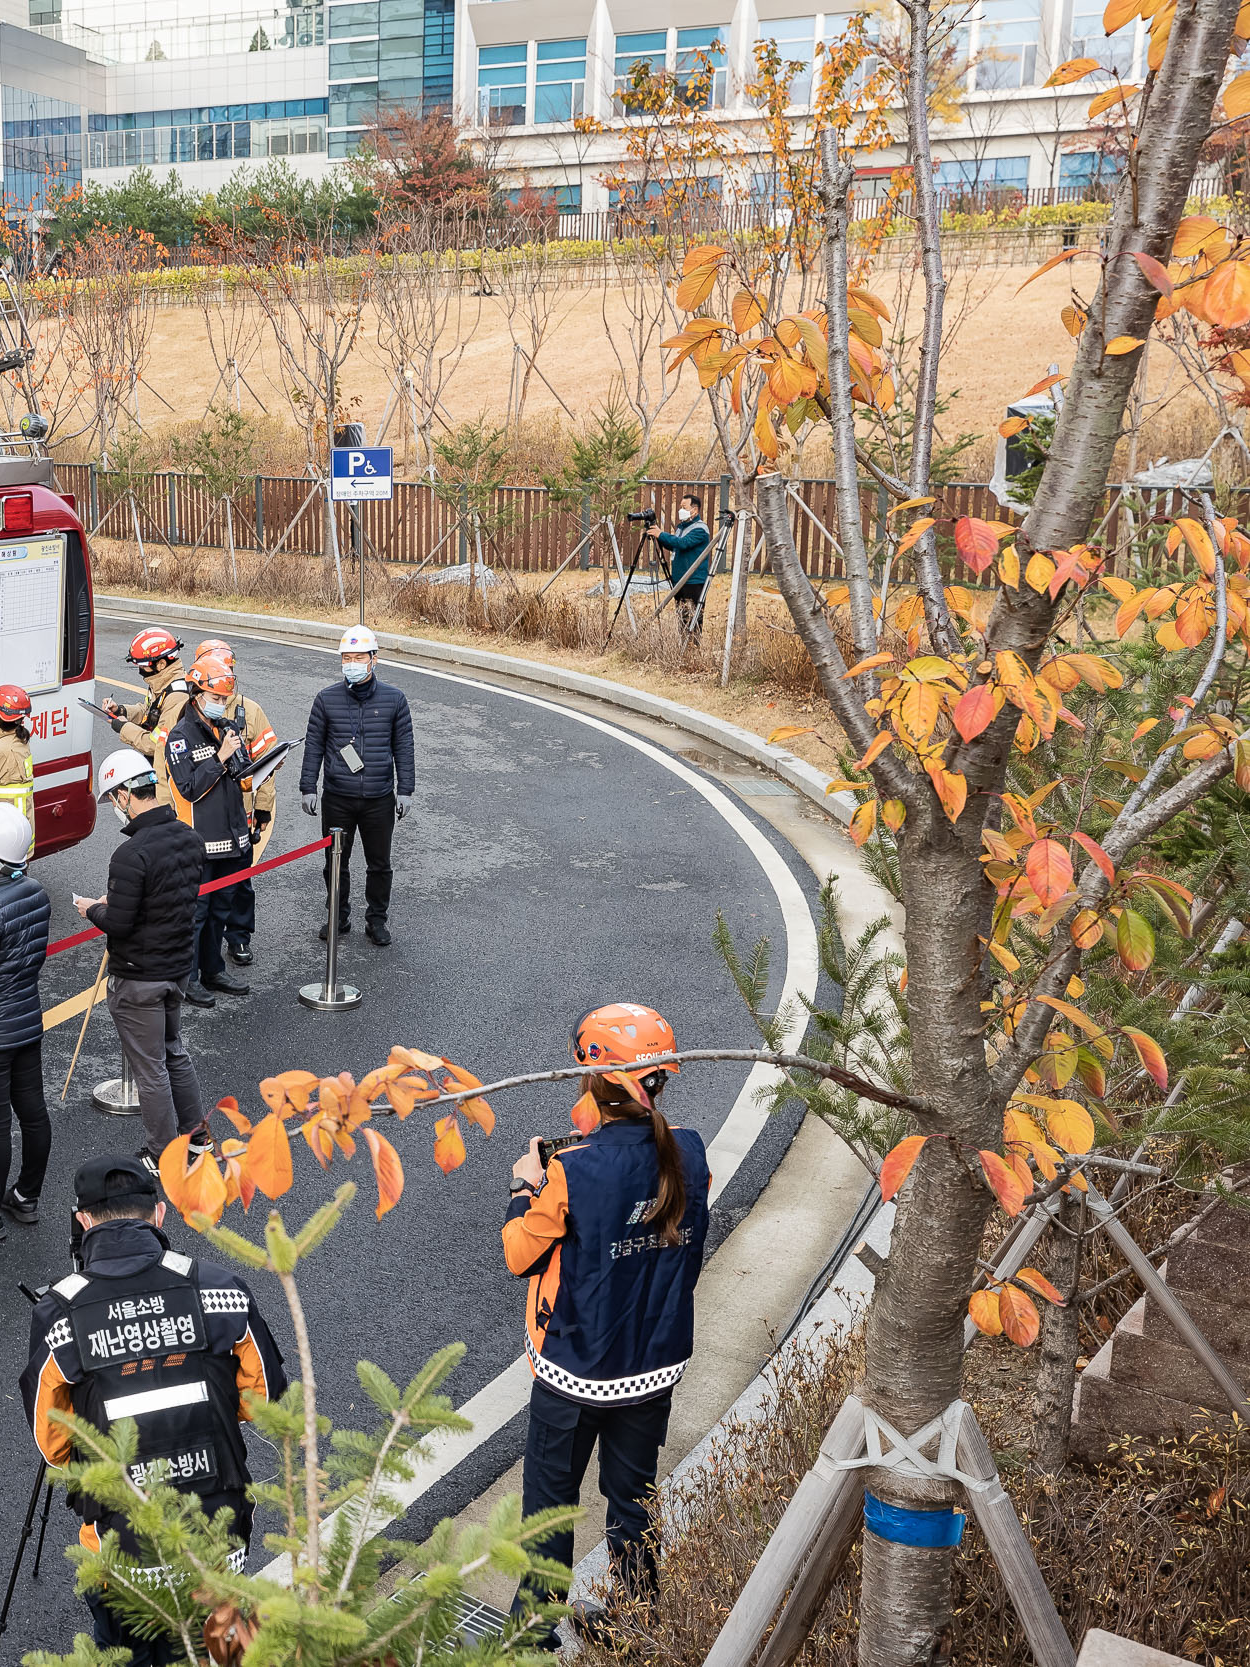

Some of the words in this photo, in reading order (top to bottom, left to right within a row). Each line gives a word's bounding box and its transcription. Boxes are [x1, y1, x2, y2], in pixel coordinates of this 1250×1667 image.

[348, 452, 365, 476] P
[108, 1296, 165, 1320] 서울소방
[88, 1314, 196, 1358] 재난영상촬영
